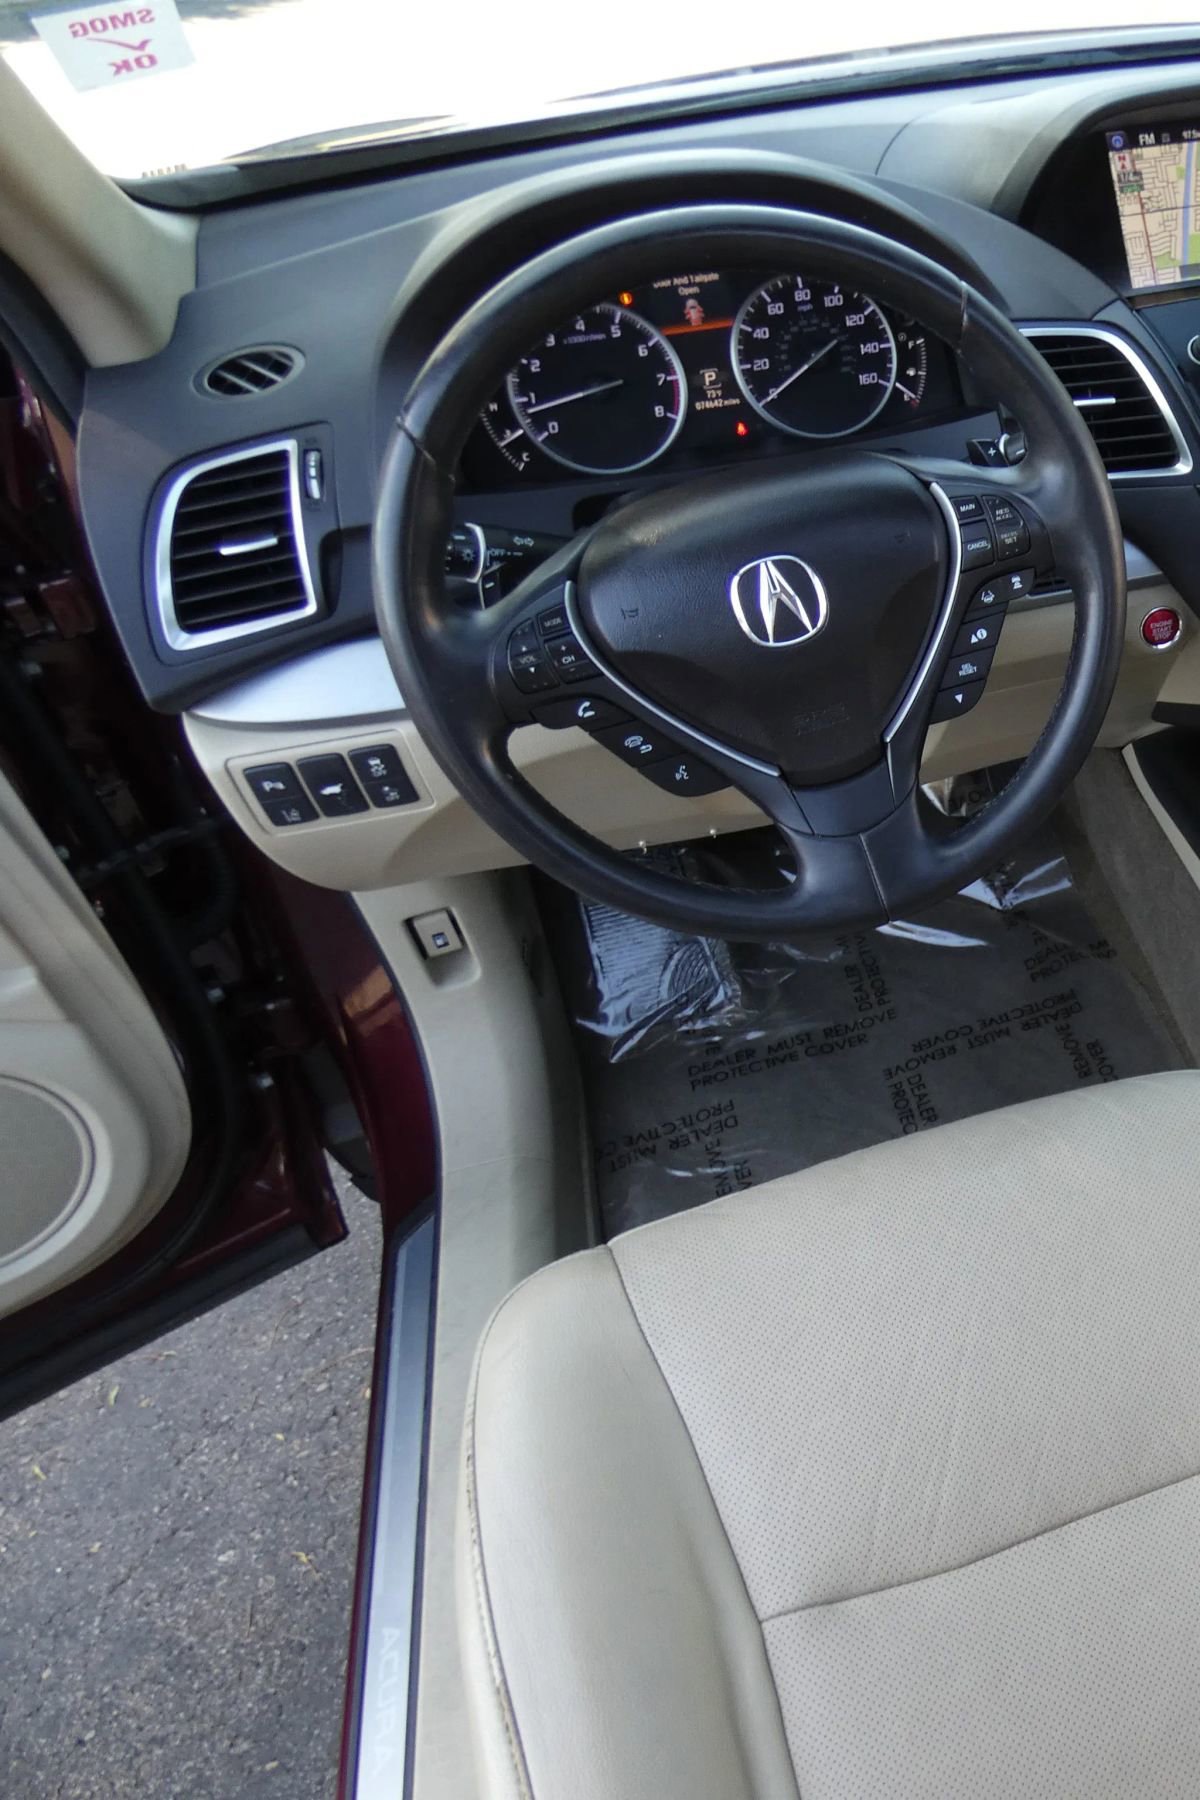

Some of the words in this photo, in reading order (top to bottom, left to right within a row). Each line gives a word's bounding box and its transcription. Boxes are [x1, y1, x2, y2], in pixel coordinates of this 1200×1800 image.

[1138, 132, 1156, 146] FM
[678, 286, 700, 296] Open
[794, 288, 811, 302] 80
[823, 293, 844, 307] 100
[767, 302, 785, 315] 60
[575, 319, 586, 332] 4
[845, 313, 865, 327] 120
[610, 325, 622, 338] 5
[752, 326, 770, 339] 40
[545, 334, 556, 347] 3
[638, 344, 649, 358] 6
[860, 341, 880, 355] 140
[529, 359, 541, 373] 2
[753, 357, 770, 371] 20
[656, 373, 667, 386] 7
[704, 370, 717, 386] P
[858, 372, 879, 385] 160
[528, 392, 537, 405] 1
[654, 405, 665, 418] 8
[548, 421, 559, 434] 0
[959, 503, 976, 513] MAIN
[967, 539, 988, 551] CANCEL
[544, 617, 564, 628] MODE
[519, 654, 537, 664] VOL
[561, 655, 576, 664] CH
[854, 933, 892, 1007] PROTECTIV
[844, 963, 873, 1012] DEALER
[976, 987, 1077, 1031] PROTECTIVE
[1020, 1002, 1084, 1032] DEALER
[687, 1047, 757, 1078] DEALER
[766, 1031, 814, 1055] MUST
[822, 1008, 898, 1039] REMOVE
[911, 1023, 974, 1054] COVER
[966, 1025, 1011, 1051] MUST
[1053, 1021, 1094, 1080] REMOVE
[689, 1052, 800, 1093] PROTECTIVE
[803, 1033, 870, 1058] COVER
[881, 1043, 959, 1081] REMOVE
[905, 1072, 940, 1127] DEALER
[887, 1082, 919, 1135] PROTEC
[623, 1098, 736, 1147] PROTECTIVE
[668, 1114, 739, 1151] DEALER
[609, 1143, 657, 1173] MUST
[704, 1137, 734, 1198] EMOVE
[372, 1626, 402, 1776] ACURA
